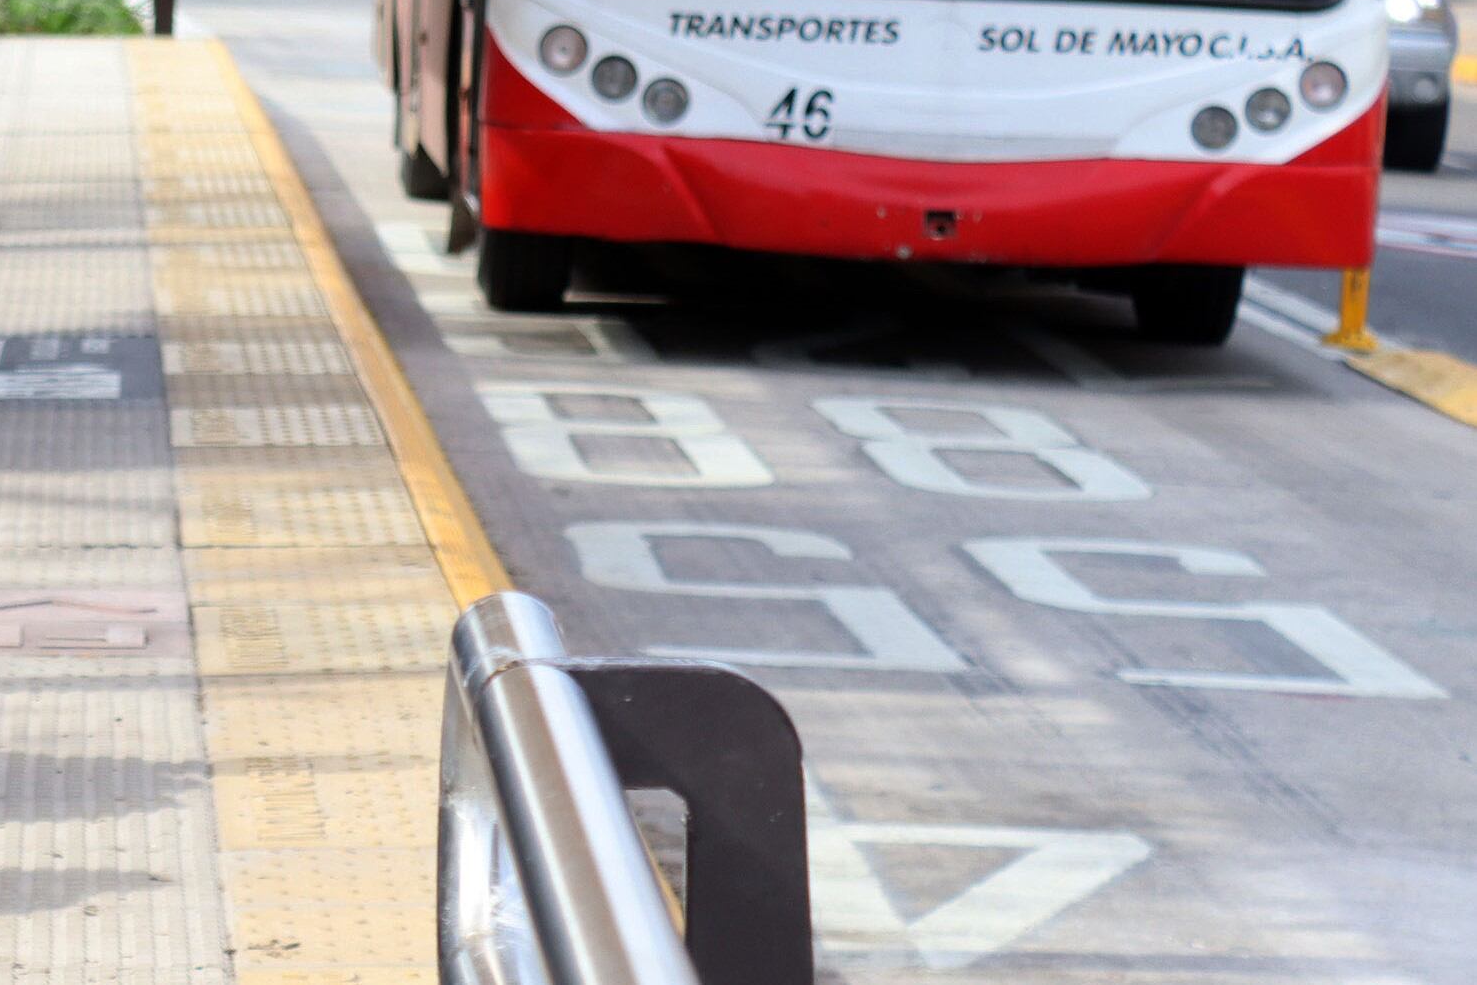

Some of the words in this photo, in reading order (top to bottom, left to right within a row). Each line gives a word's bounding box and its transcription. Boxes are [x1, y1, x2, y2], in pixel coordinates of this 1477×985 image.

[670, 12, 900, 44] TRANSPORTES
[978, 26, 1039, 53] SOL
[1054, 28, 1097, 54] DE
[1109, 31, 1202, 57] MAYO
[765, 86, 835, 140] 46
